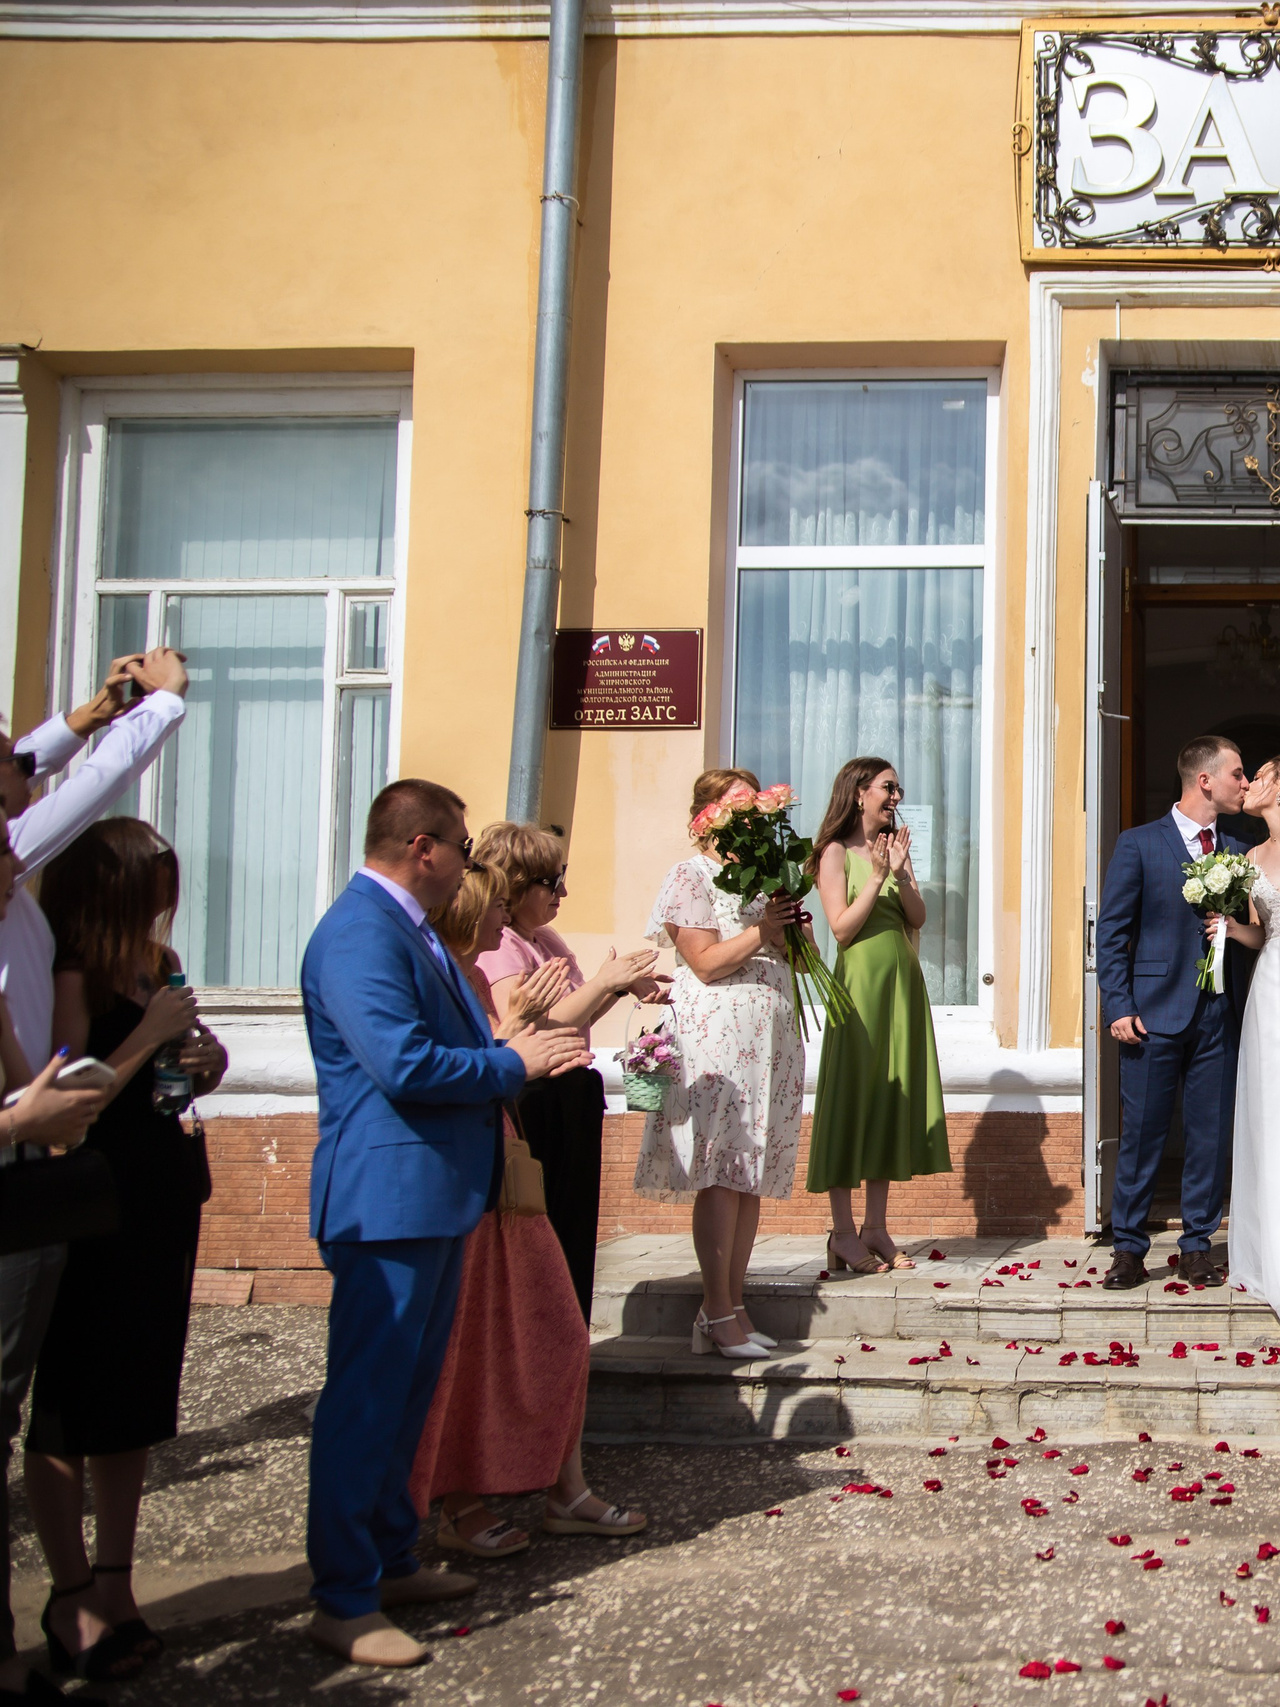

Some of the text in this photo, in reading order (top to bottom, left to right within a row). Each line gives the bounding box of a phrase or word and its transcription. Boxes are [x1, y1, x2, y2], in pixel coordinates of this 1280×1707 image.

[580, 695, 637, 703] ВОЛГОГРАДСКОЙ
[574, 706, 677, 724] отдел ЗАГС
